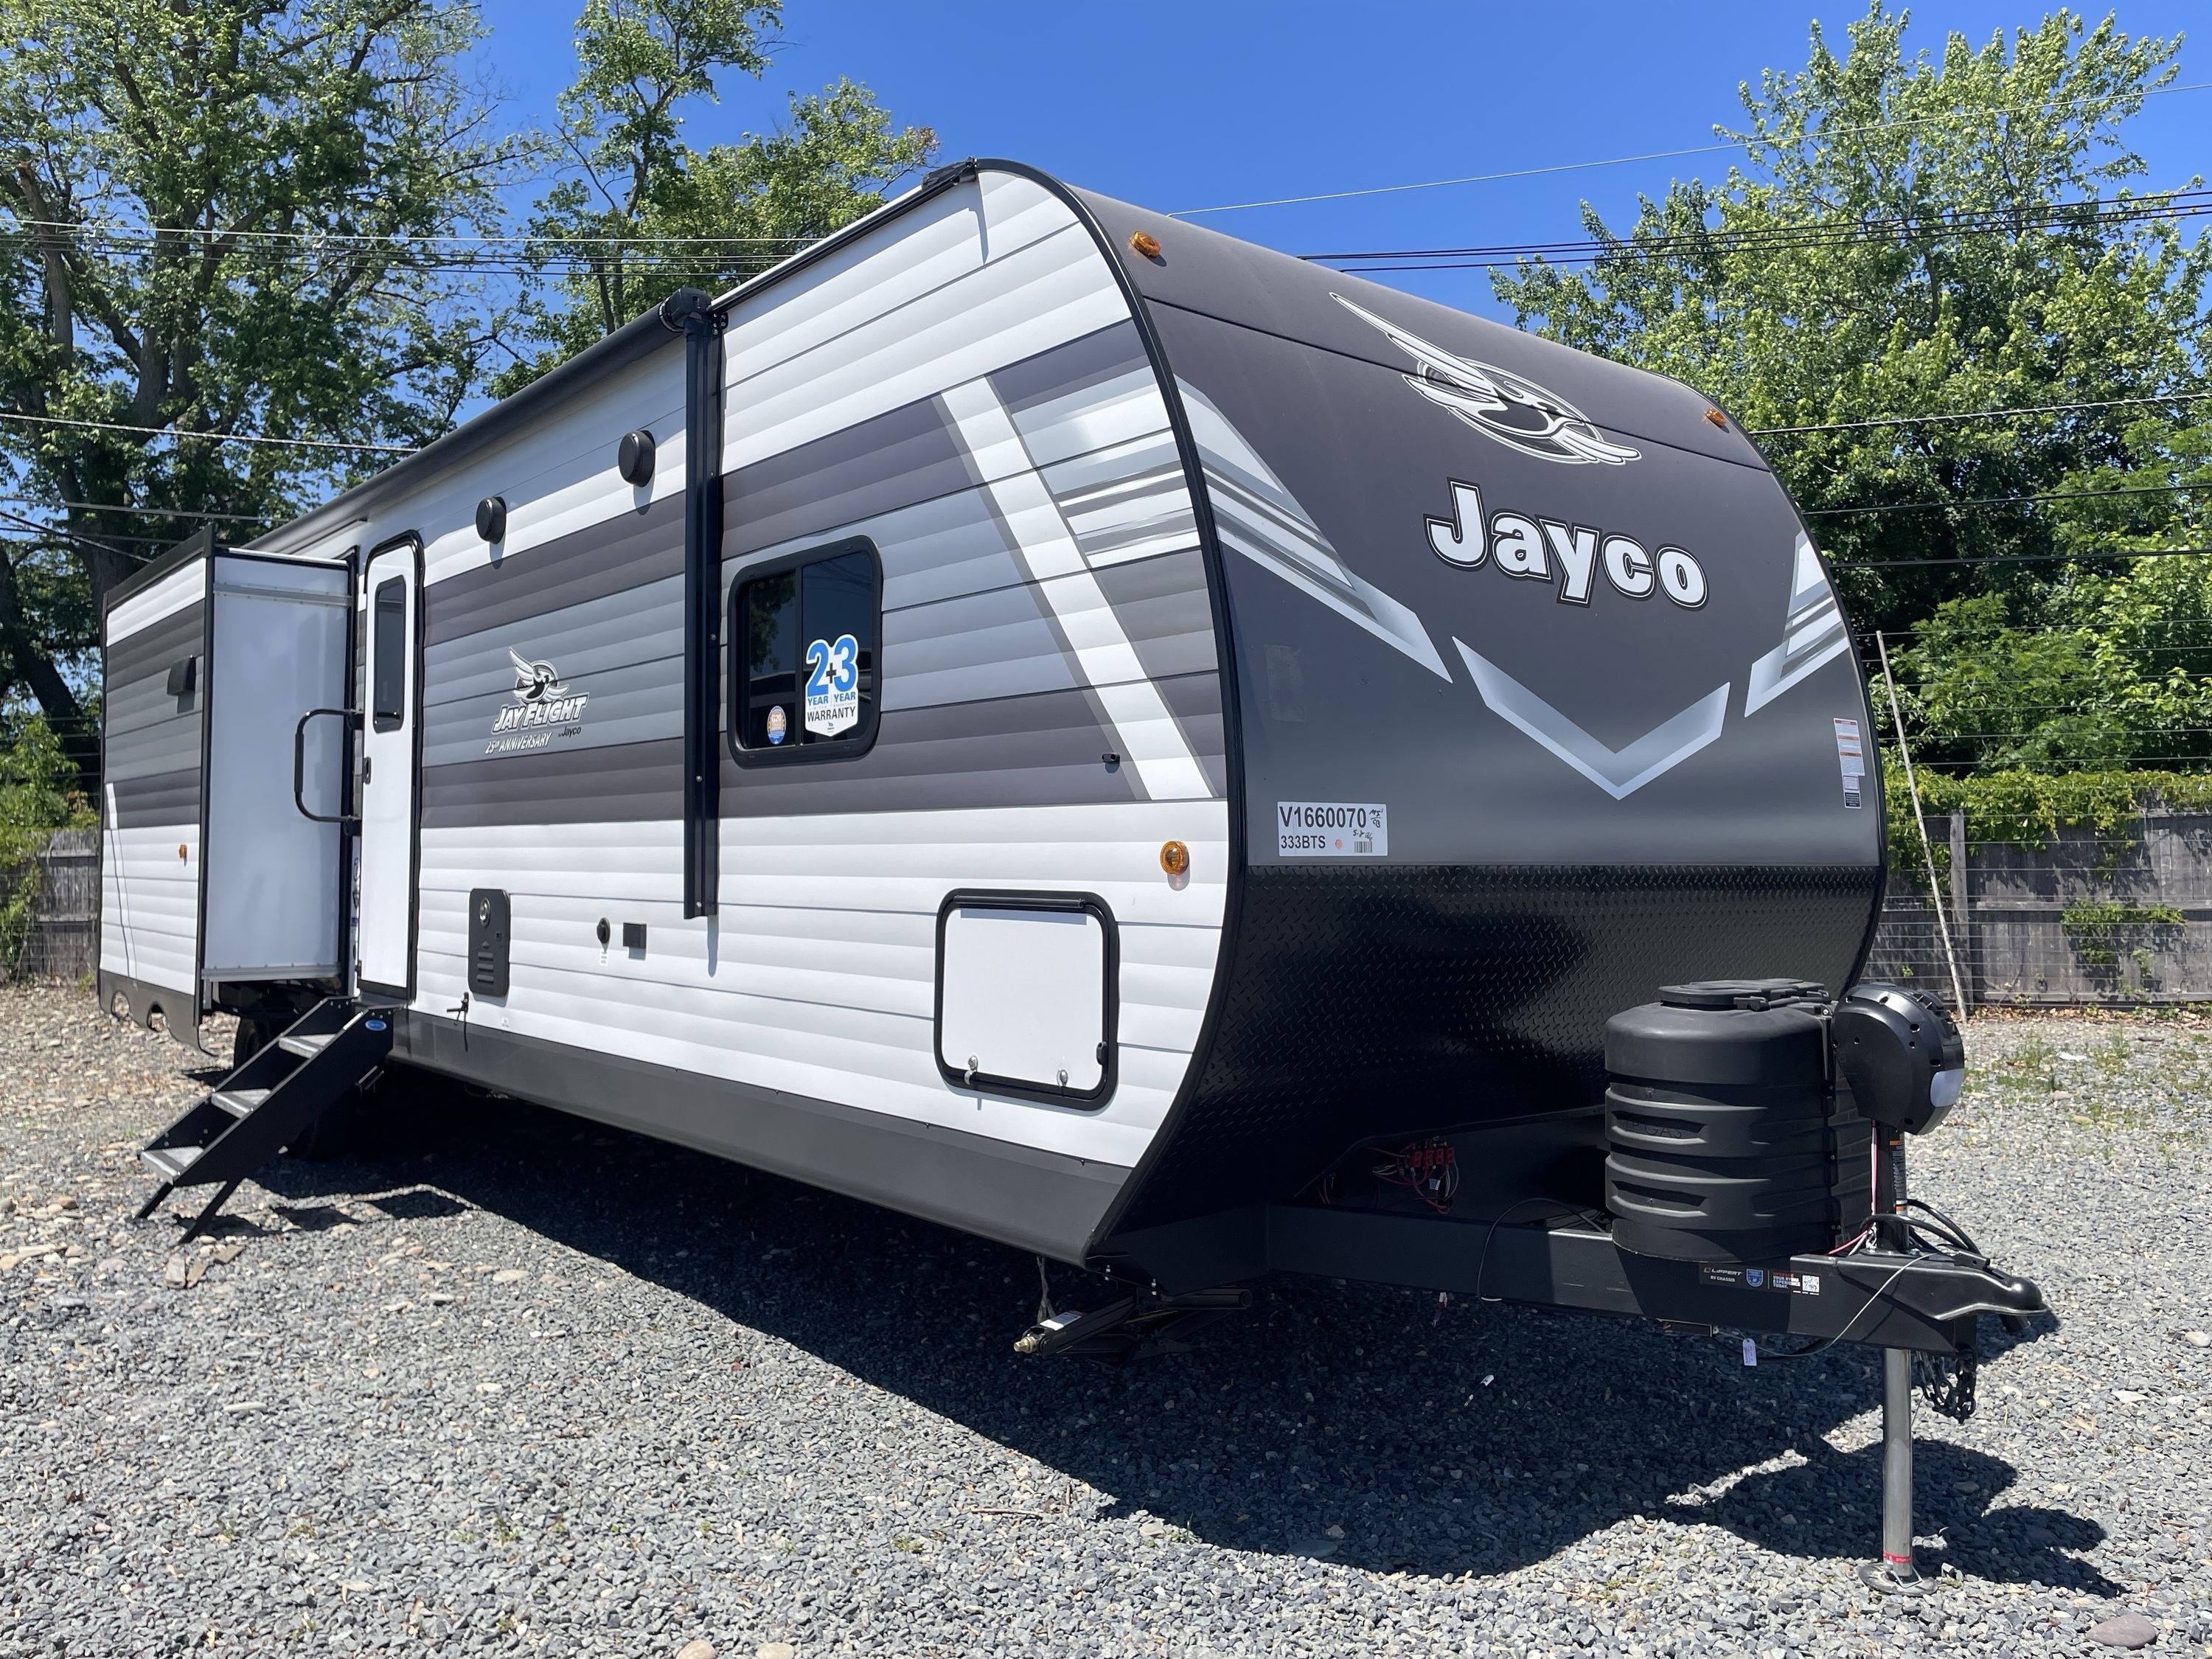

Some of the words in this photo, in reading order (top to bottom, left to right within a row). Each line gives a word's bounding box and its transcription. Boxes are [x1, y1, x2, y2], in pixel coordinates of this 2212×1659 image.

[1425, 478, 1709, 610] Jayco
[807, 695, 829, 706] YEAR
[834, 692, 856, 703] YEAR
[493, 706, 526, 733] JAY
[521, 695, 588, 728] FLIGHT
[807, 706, 855, 723] WARRANTY
[561, 726, 582, 738] Jayco
[499, 731, 552, 753] ANNIVERSARY
[1279, 806, 1366, 828] V1660070
[1281, 835, 1326, 849] 333BTS
[1645, 1124, 1683, 1138] GAS
